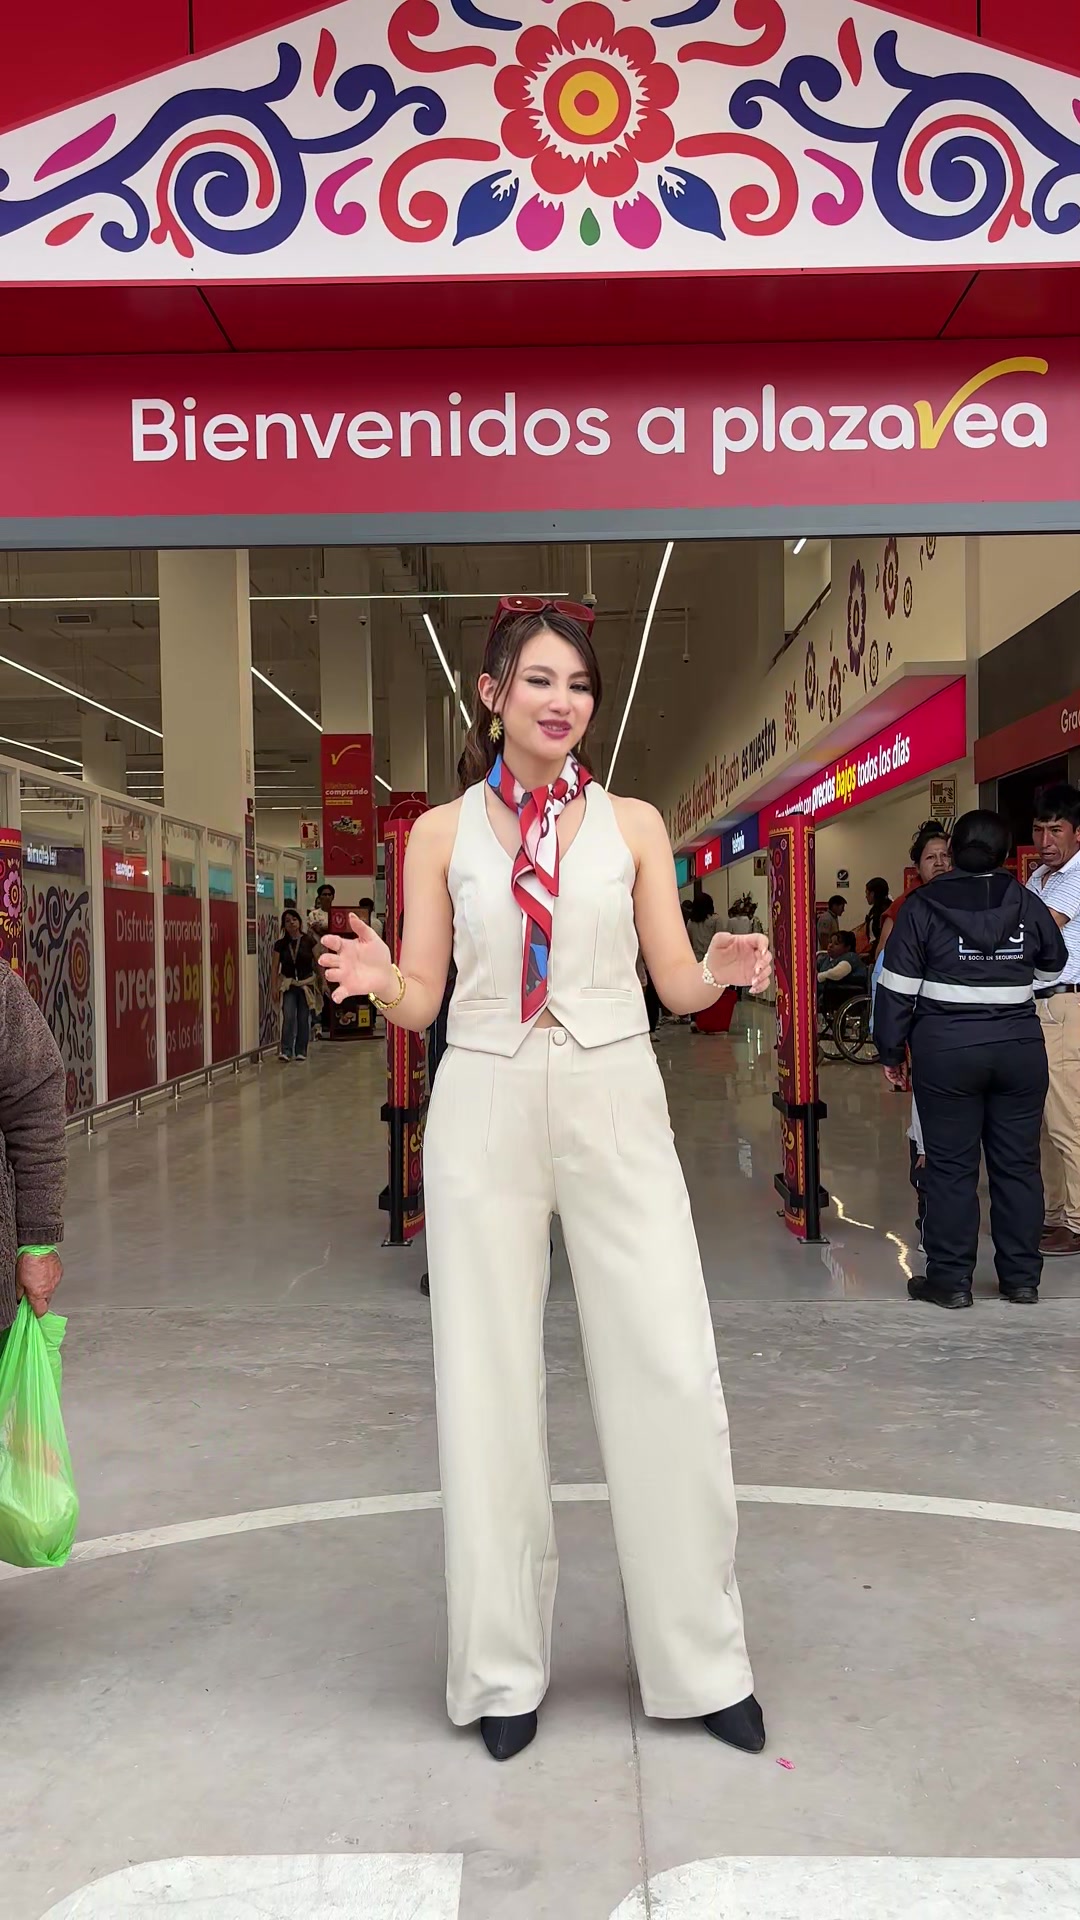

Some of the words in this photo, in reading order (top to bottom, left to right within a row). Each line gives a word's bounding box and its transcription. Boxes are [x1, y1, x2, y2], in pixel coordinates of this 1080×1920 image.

[131, 391, 612, 462] Bienvenidos
[637, 405, 687, 455] a
[742, 746, 749, 781] es
[749, 717, 776, 776] nuestro
[804, 796, 812, 815] con
[811, 772, 835, 816] precios
[835, 760, 856, 804] bajos
[857, 752, 878, 787] todos
[879, 745, 891, 776] los
[892, 733, 910, 769] días
[325, 787, 368, 797] comprando
[116, 909, 154, 942] Disfruta
[163, 914, 202, 948] omprando
[115, 966, 180, 1029] precos
[183, 952, 220, 1012] bajs
[146, 1030, 177, 1060] toos
[179, 1019, 190, 1049] los
